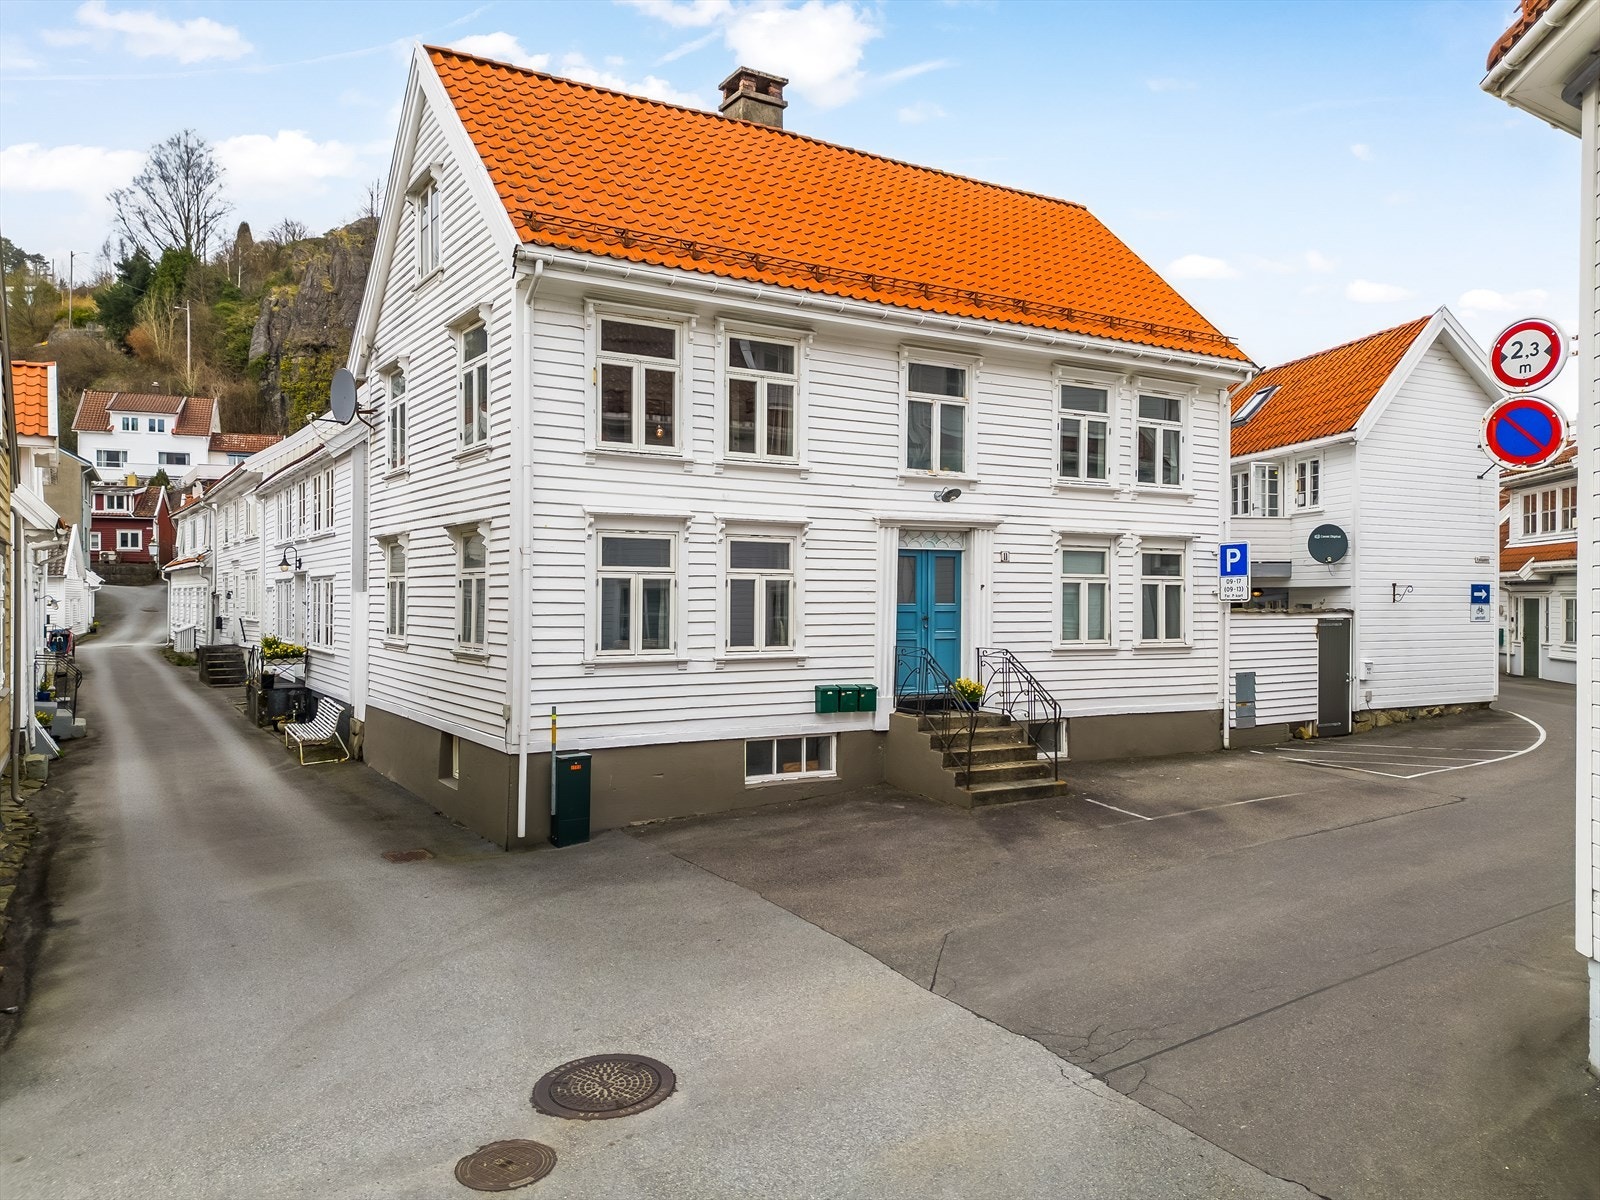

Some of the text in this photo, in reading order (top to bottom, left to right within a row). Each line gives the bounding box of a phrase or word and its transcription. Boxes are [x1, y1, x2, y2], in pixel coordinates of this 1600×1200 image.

[1511, 341, 1539, 360] 2,3
[1520, 364, 1532, 374] m
[1226, 548, 1241, 572] P
